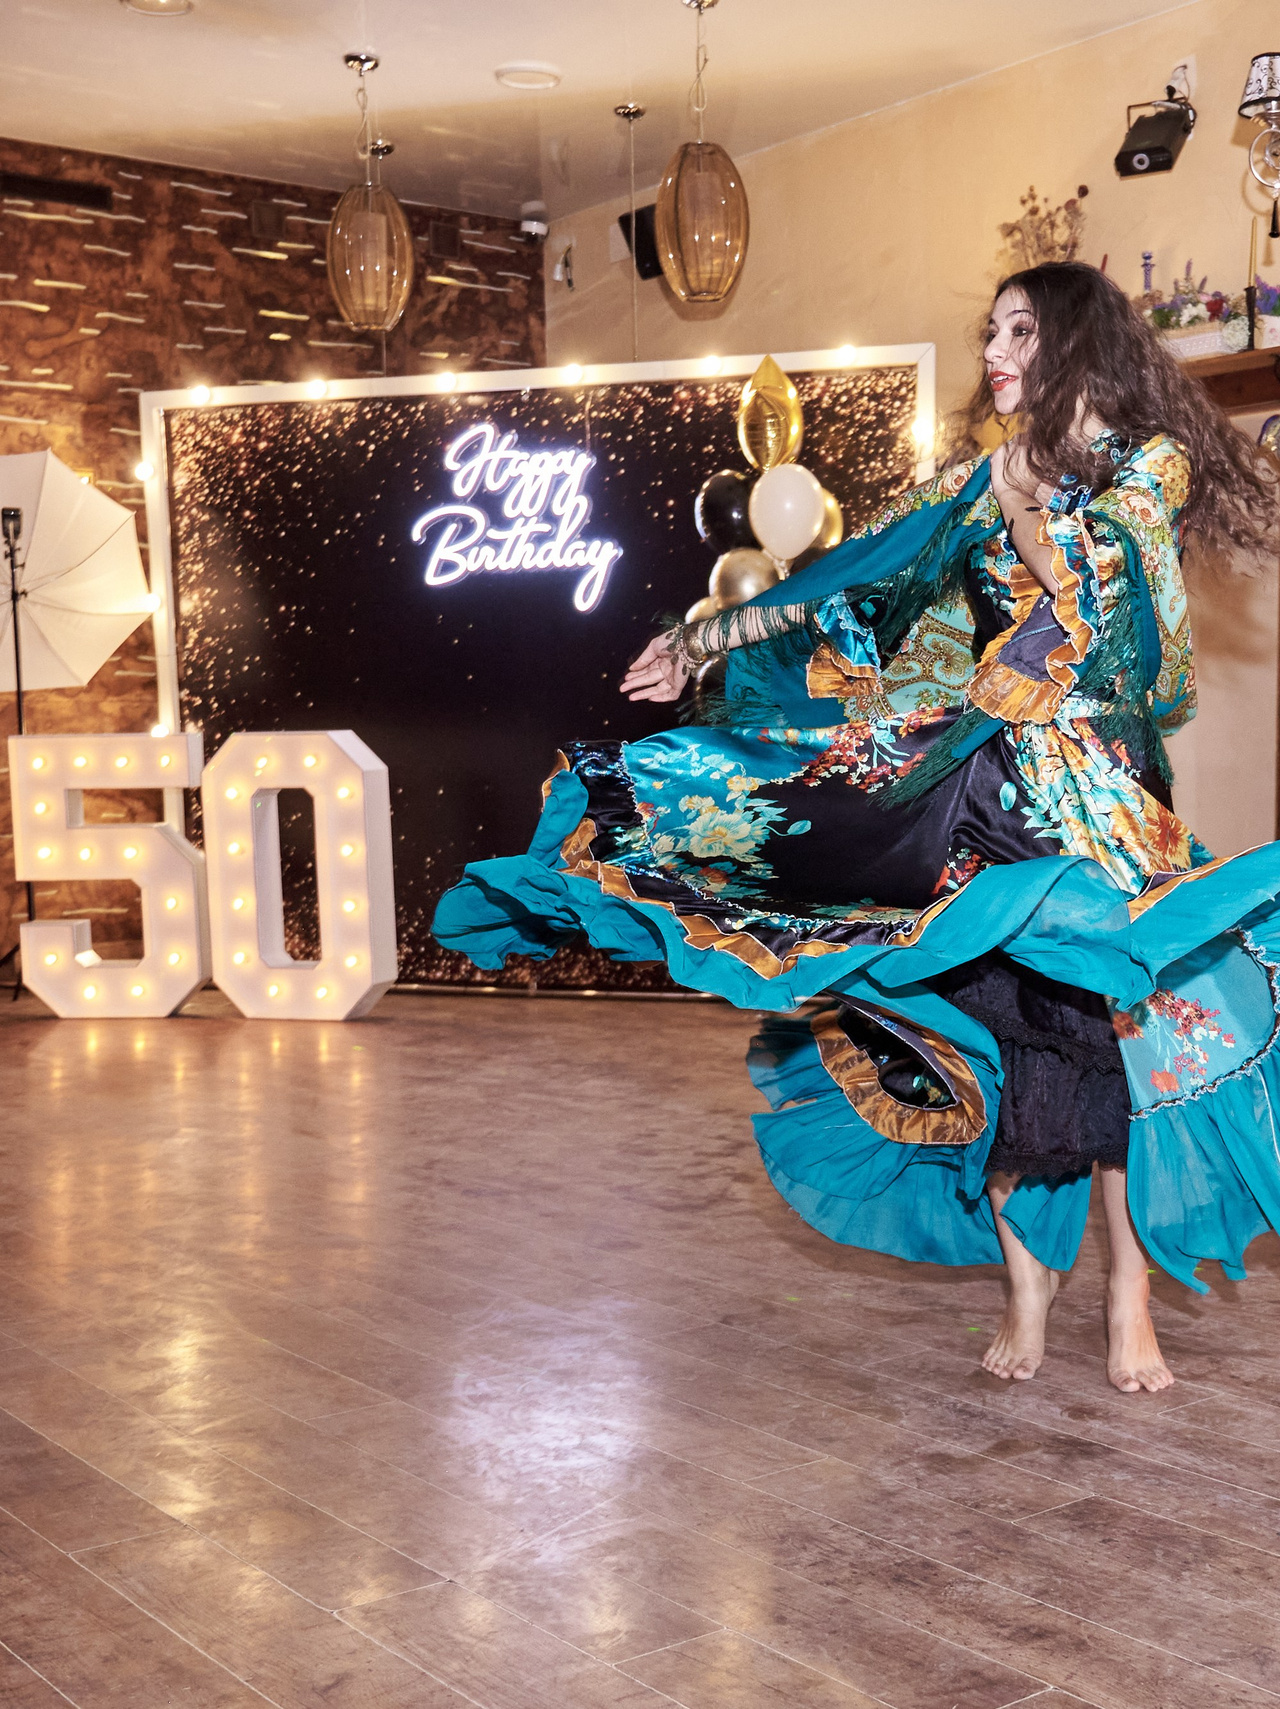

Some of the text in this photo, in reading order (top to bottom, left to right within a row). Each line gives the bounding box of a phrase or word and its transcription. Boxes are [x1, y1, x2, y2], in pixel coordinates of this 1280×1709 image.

[444, 423, 594, 518] Happy
[411, 495, 622, 611] Birthday
[8, 730, 398, 1021] 50
